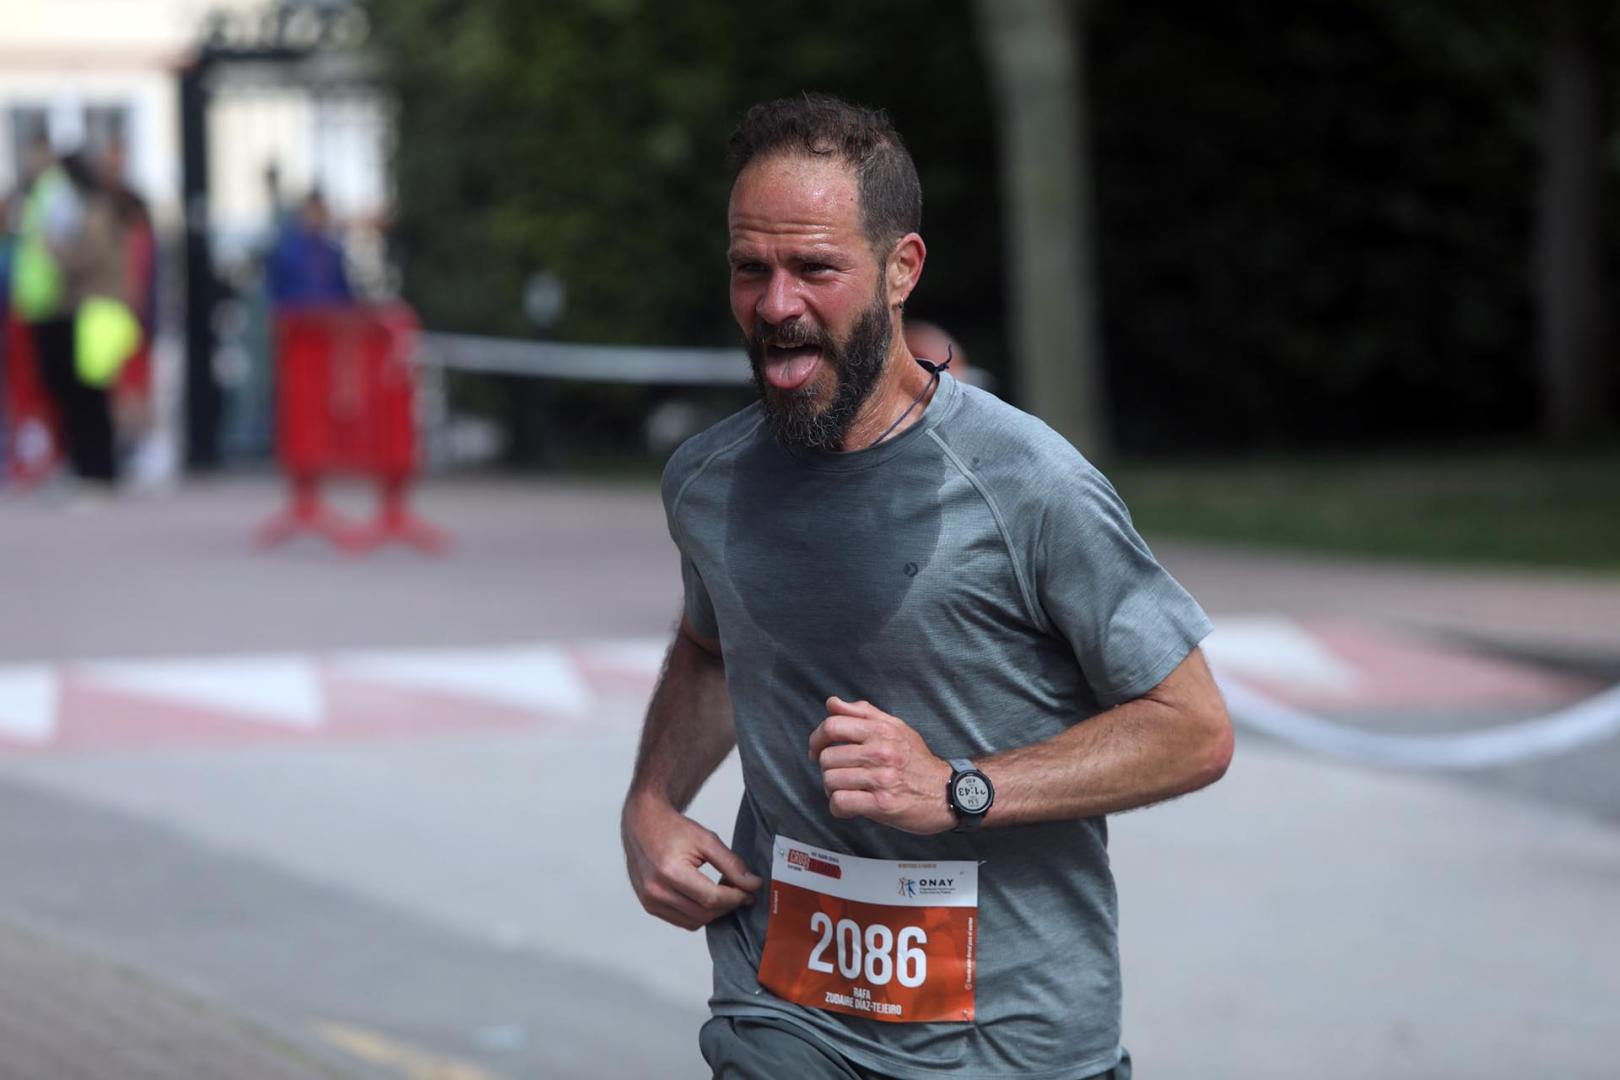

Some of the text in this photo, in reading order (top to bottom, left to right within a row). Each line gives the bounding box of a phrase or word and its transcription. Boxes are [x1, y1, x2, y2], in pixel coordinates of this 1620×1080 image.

[919, 878, 954, 887] ONAY
[808, 912, 927, 987] 2086
[825, 991, 854, 1008] ZUDAIRE
[853, 987, 871, 999] RAFA
